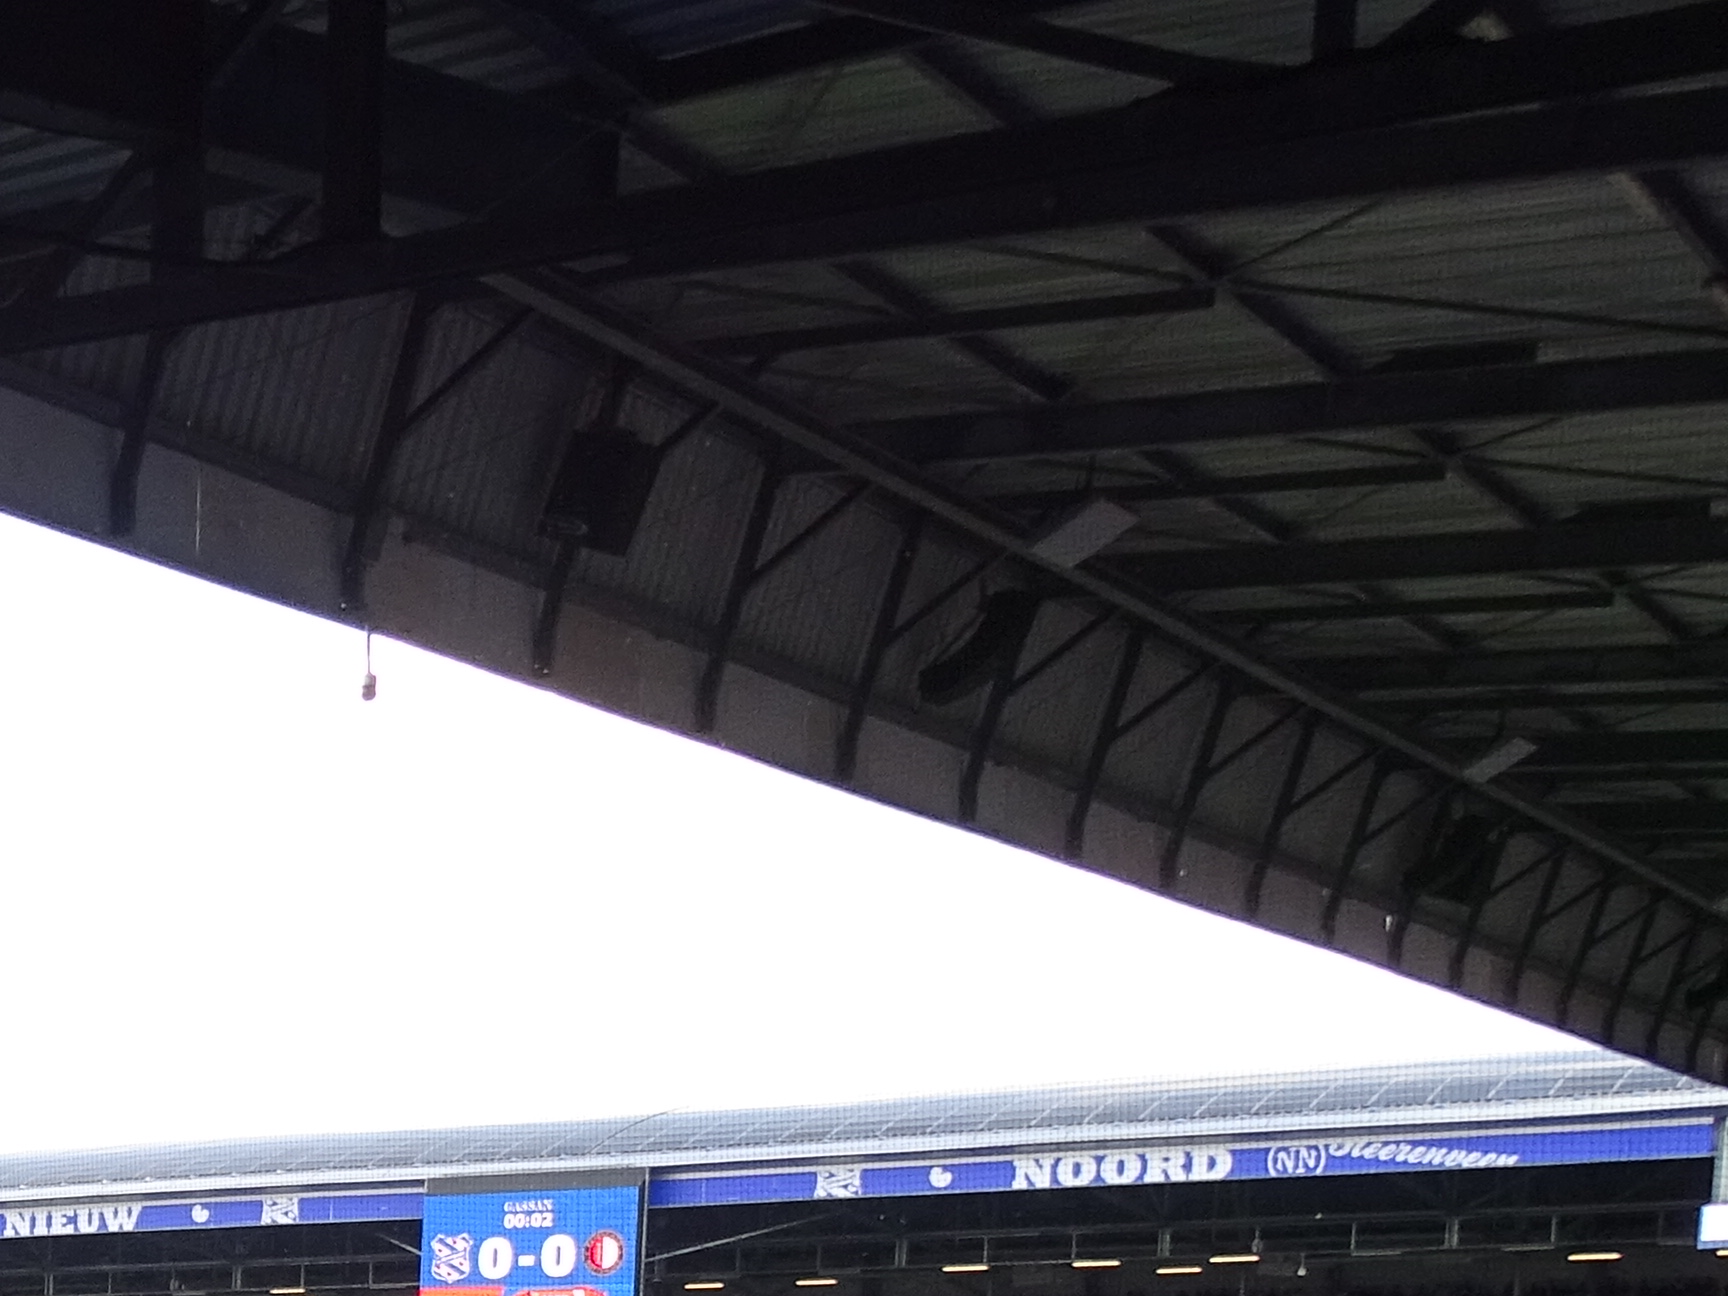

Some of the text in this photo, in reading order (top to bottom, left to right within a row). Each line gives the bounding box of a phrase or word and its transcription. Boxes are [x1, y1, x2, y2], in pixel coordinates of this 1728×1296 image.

[1012, 1149, 1232, 1190] NOORD
[3, 1203, 142, 1238] NIEUW
[503, 1212, 553, 1228] 00:02
